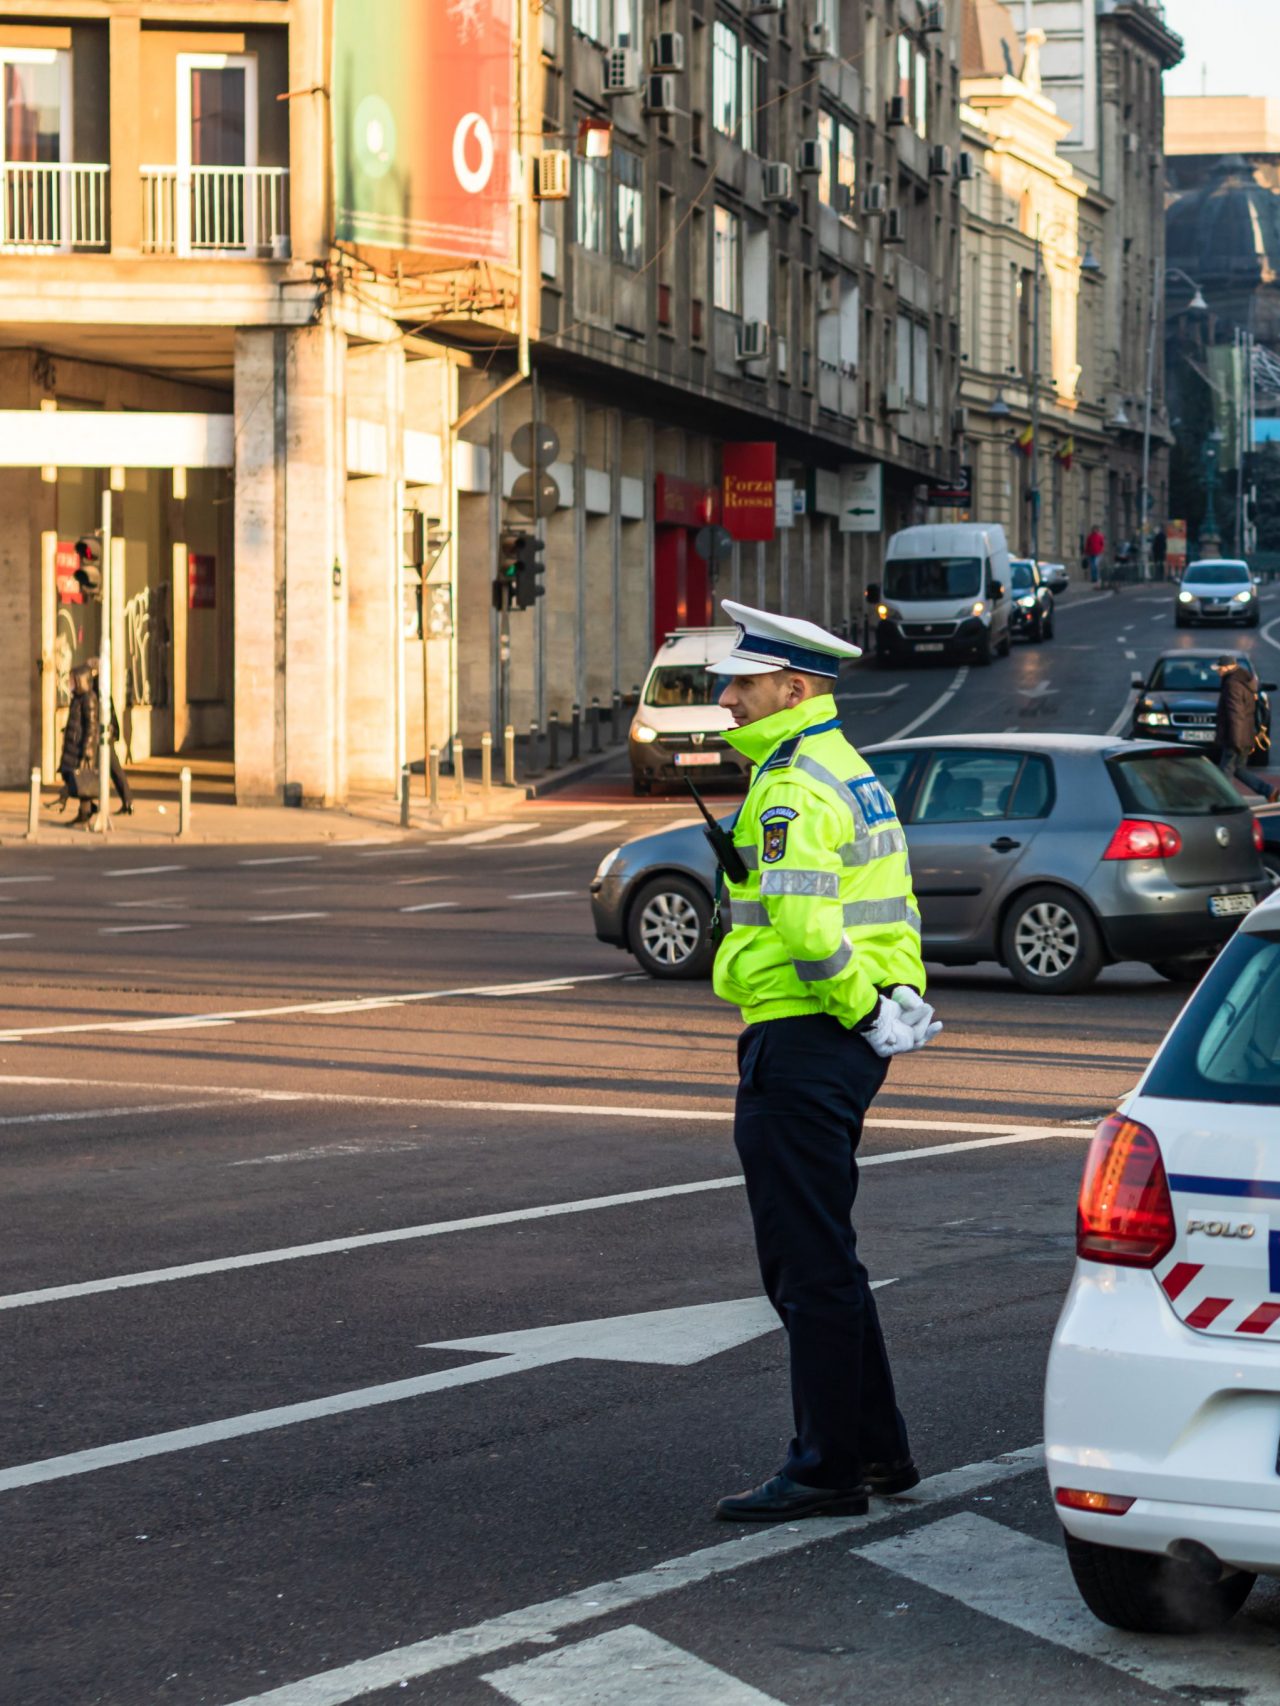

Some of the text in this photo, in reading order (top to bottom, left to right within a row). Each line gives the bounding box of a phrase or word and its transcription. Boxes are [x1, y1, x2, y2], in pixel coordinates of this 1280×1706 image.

[724, 475, 773, 492] Forza
[724, 492, 773, 508] Rossa
[1186, 1220, 1255, 1240] POLO
